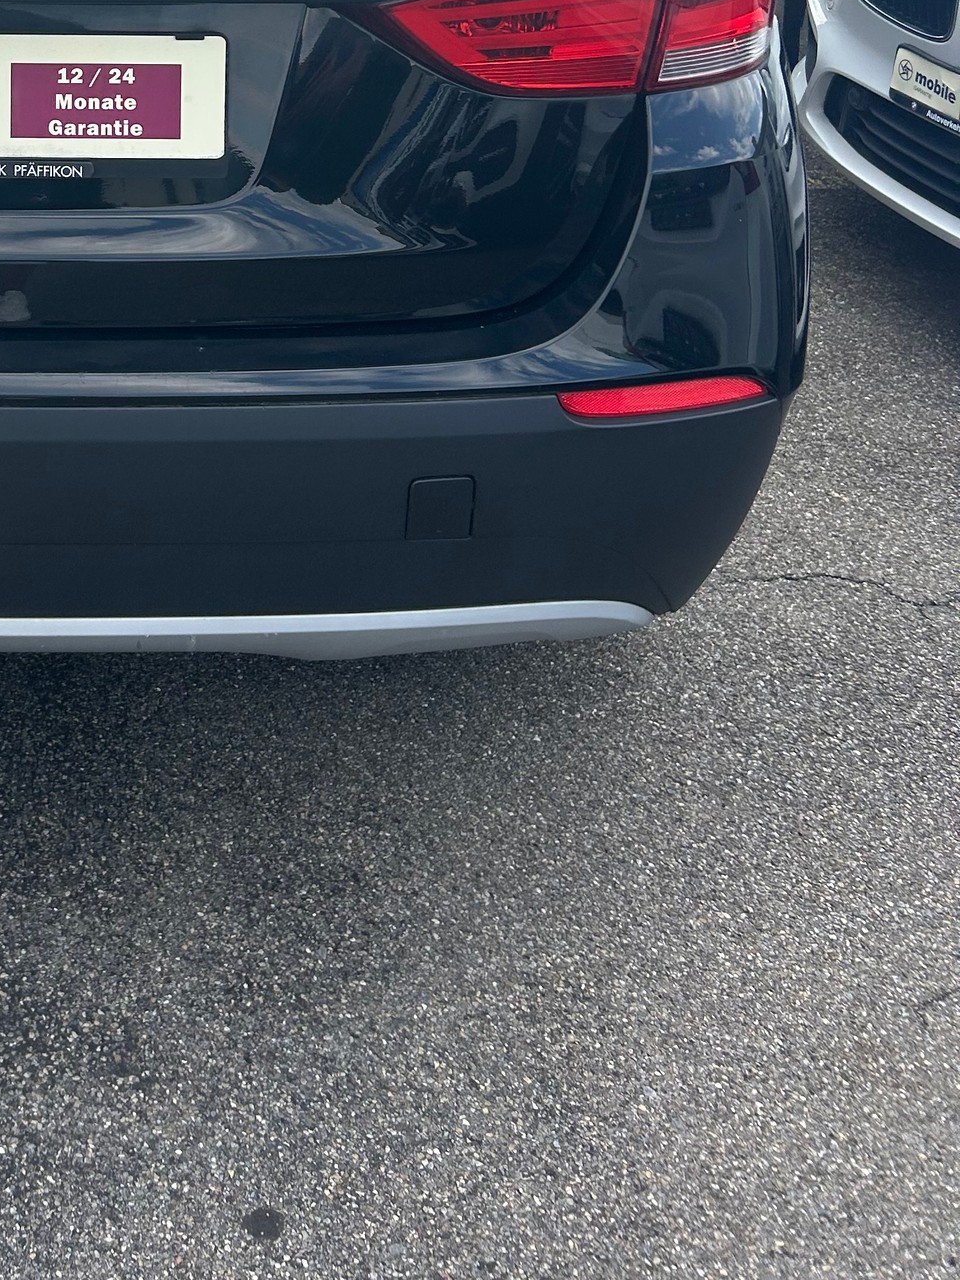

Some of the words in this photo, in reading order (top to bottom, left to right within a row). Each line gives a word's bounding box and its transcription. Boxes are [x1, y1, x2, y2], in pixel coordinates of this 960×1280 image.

[57, 67, 83, 84] 12
[108, 68, 136, 85] 24
[915, 71, 956, 104] mobile
[55, 93, 137, 110] Monate
[48, 119, 143, 136] Garantie
[14, 162, 83, 178] PFÄFFIKON
